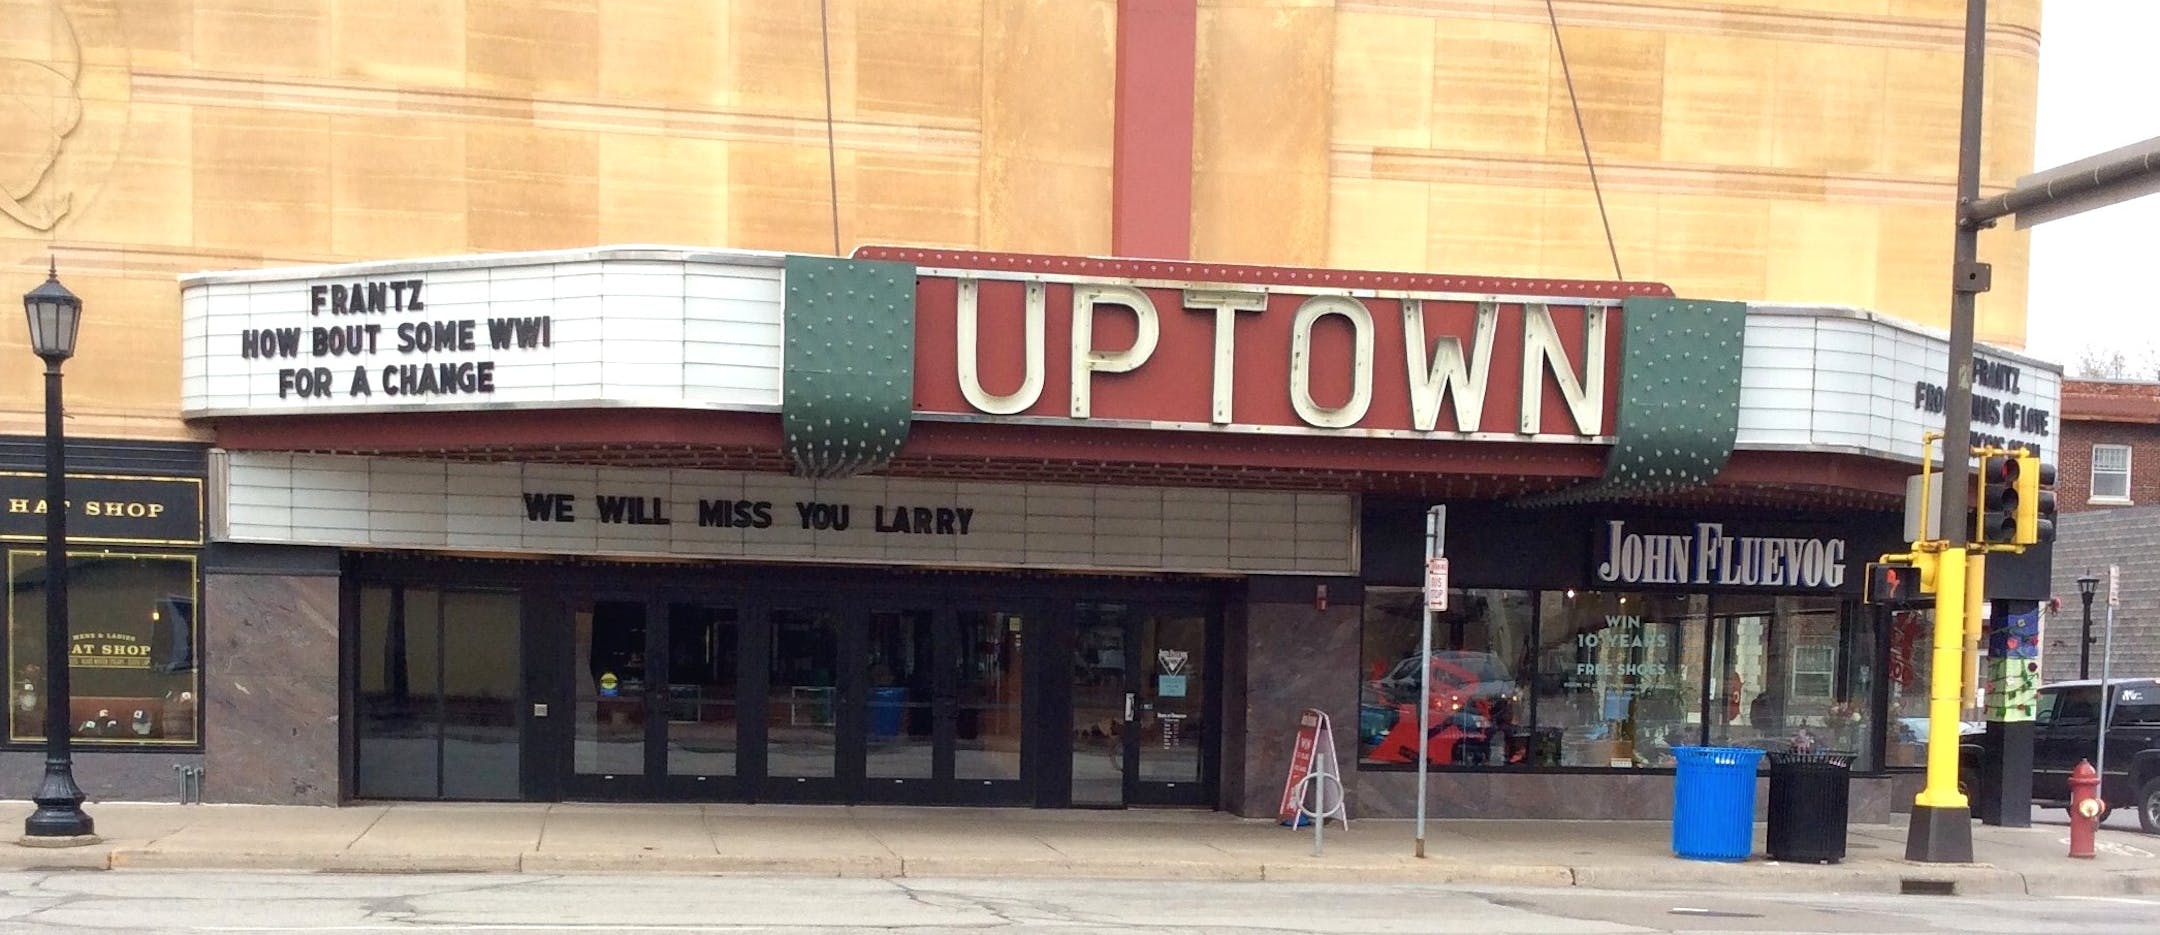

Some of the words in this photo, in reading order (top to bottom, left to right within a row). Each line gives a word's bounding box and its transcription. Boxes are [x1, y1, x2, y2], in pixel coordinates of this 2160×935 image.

[311, 280, 424, 315] FRANTZ
[241, 327, 300, 358] HOW
[313, 324, 381, 357] BOUT
[397, 320, 476, 352] SOME
[488, 316, 551, 348] WWI
[957, 278, 1607, 436] UPTOWN
[279, 368, 332, 398] FOR
[350, 365, 371, 396] A
[382, 362, 495, 395] CHANGE
[2003, 401, 2020, 429] OF
[2021, 405, 2049, 437] LOVE
[9, 498, 70, 514] HA
[86, 501, 164, 518] SHOP
[523, 493, 575, 522] WE
[596, 495, 670, 525] WILL
[699, 500, 772, 529] MISS
[796, 502, 850, 531] YOU
[875, 505, 974, 534] LARRY
[1599, 520, 1692, 584] JOHN
[1695, 522, 1846, 588] FLUEVOG
[1605, 615, 1640, 628] WIN
[70, 644, 95, 654] AT
[101, 644, 151, 656] SHOP
[1577, 633, 1599, 648] 10
[1607, 634, 1668, 648] YEARS
[1577, 664, 1613, 676] FREE
[1617, 664, 1667, 676] SHOES
